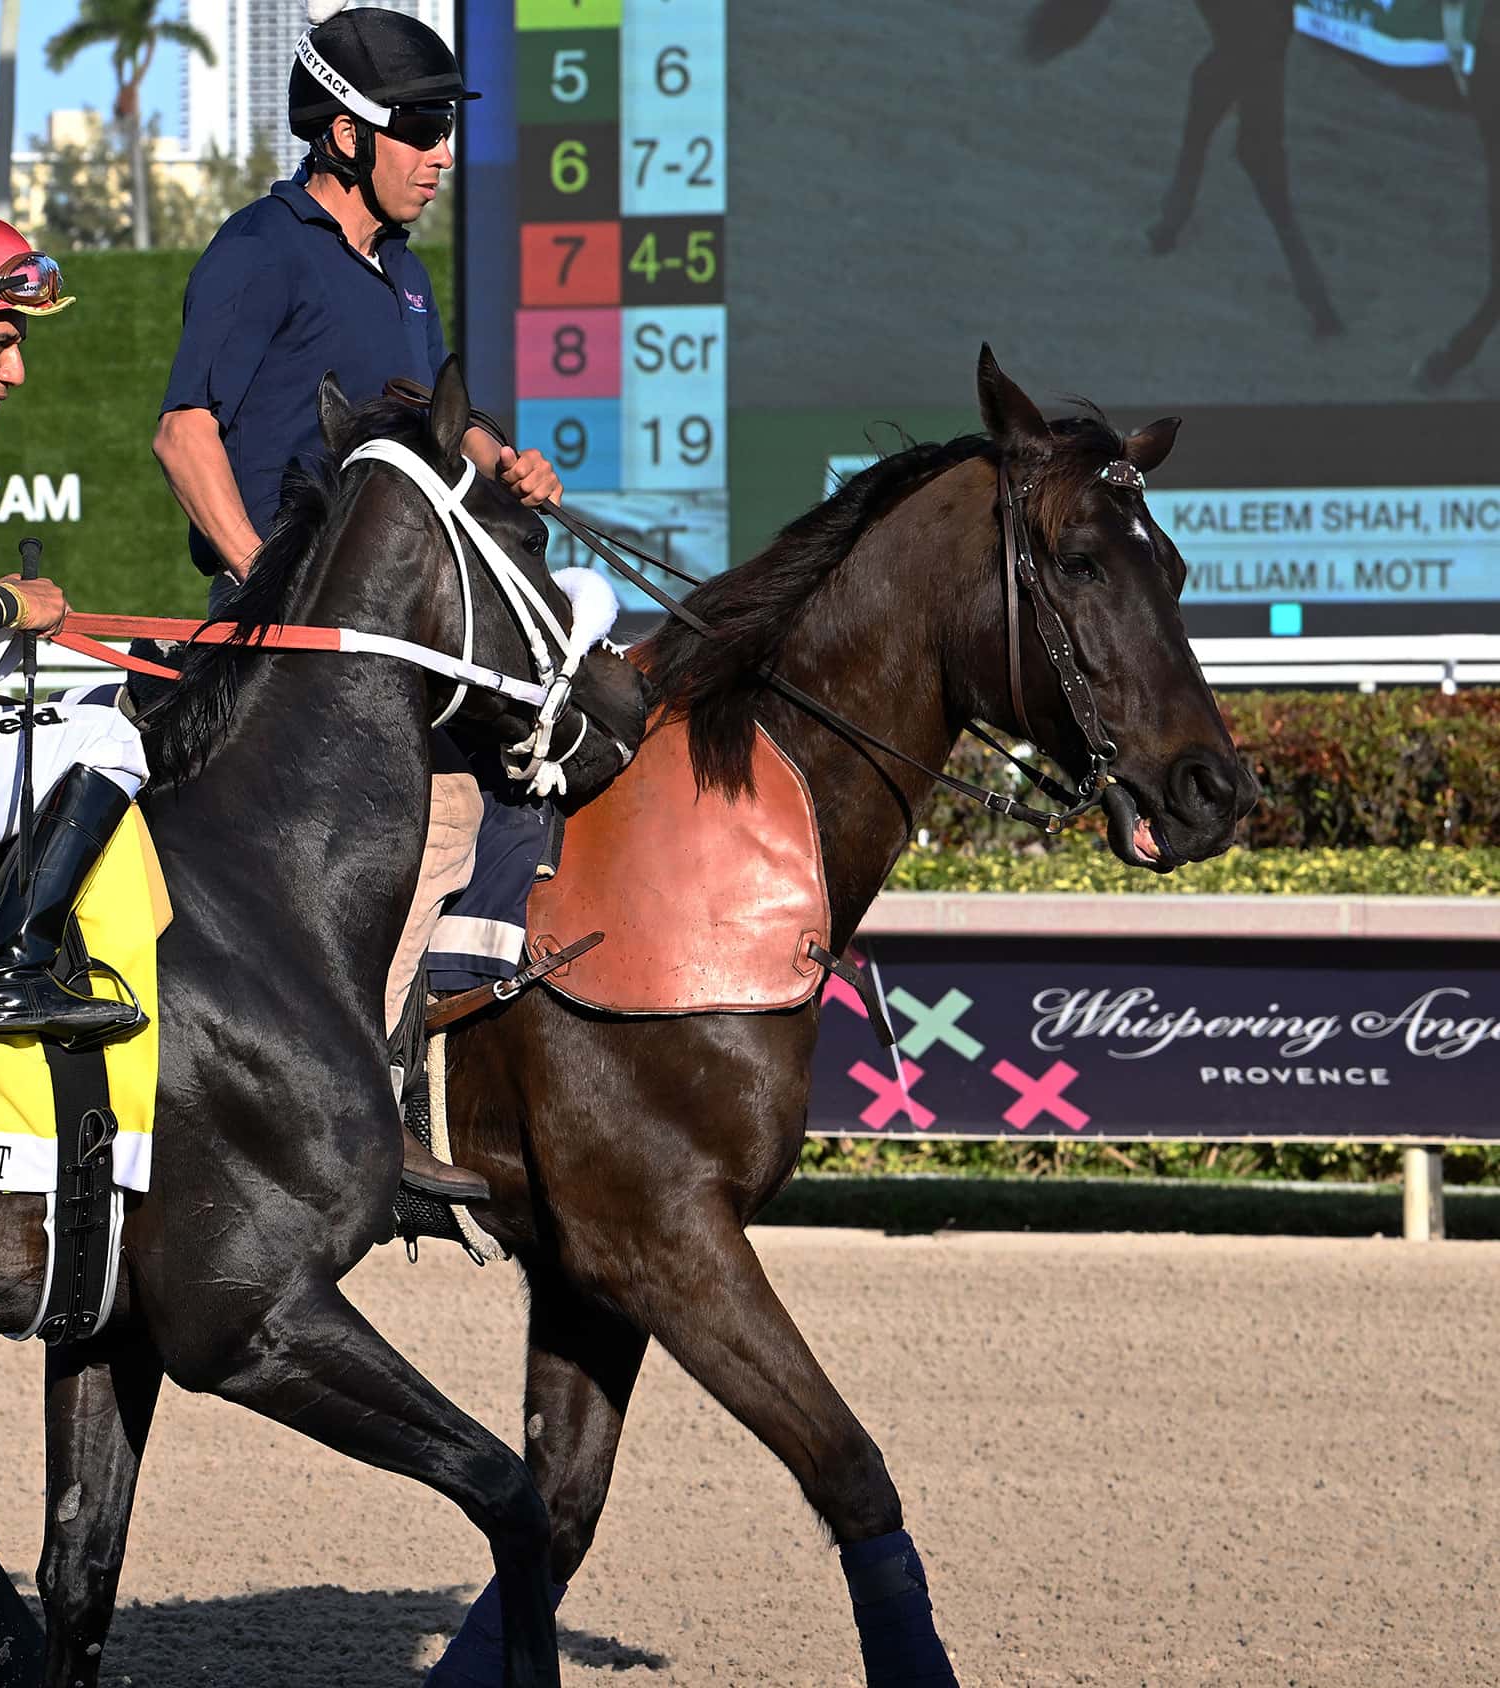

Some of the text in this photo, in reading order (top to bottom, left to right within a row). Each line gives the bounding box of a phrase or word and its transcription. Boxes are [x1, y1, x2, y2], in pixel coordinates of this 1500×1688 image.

[551, 45, 691, 103] 5 6
[551, 136, 714, 193] 6 7-2
[552, 232, 716, 286] 7 4-5
[552, 323, 717, 377] 8 Scr
[553, 416, 712, 470] 9 19
[1173, 498, 1500, 536] KALEEM SHAH, INC
[1327, 560, 1345, 591] I.
[1354, 558, 1453, 591] MOTT
[1031, 986, 1342, 1060] Whispering
[1200, 1066, 1390, 1086] PROVENCE
